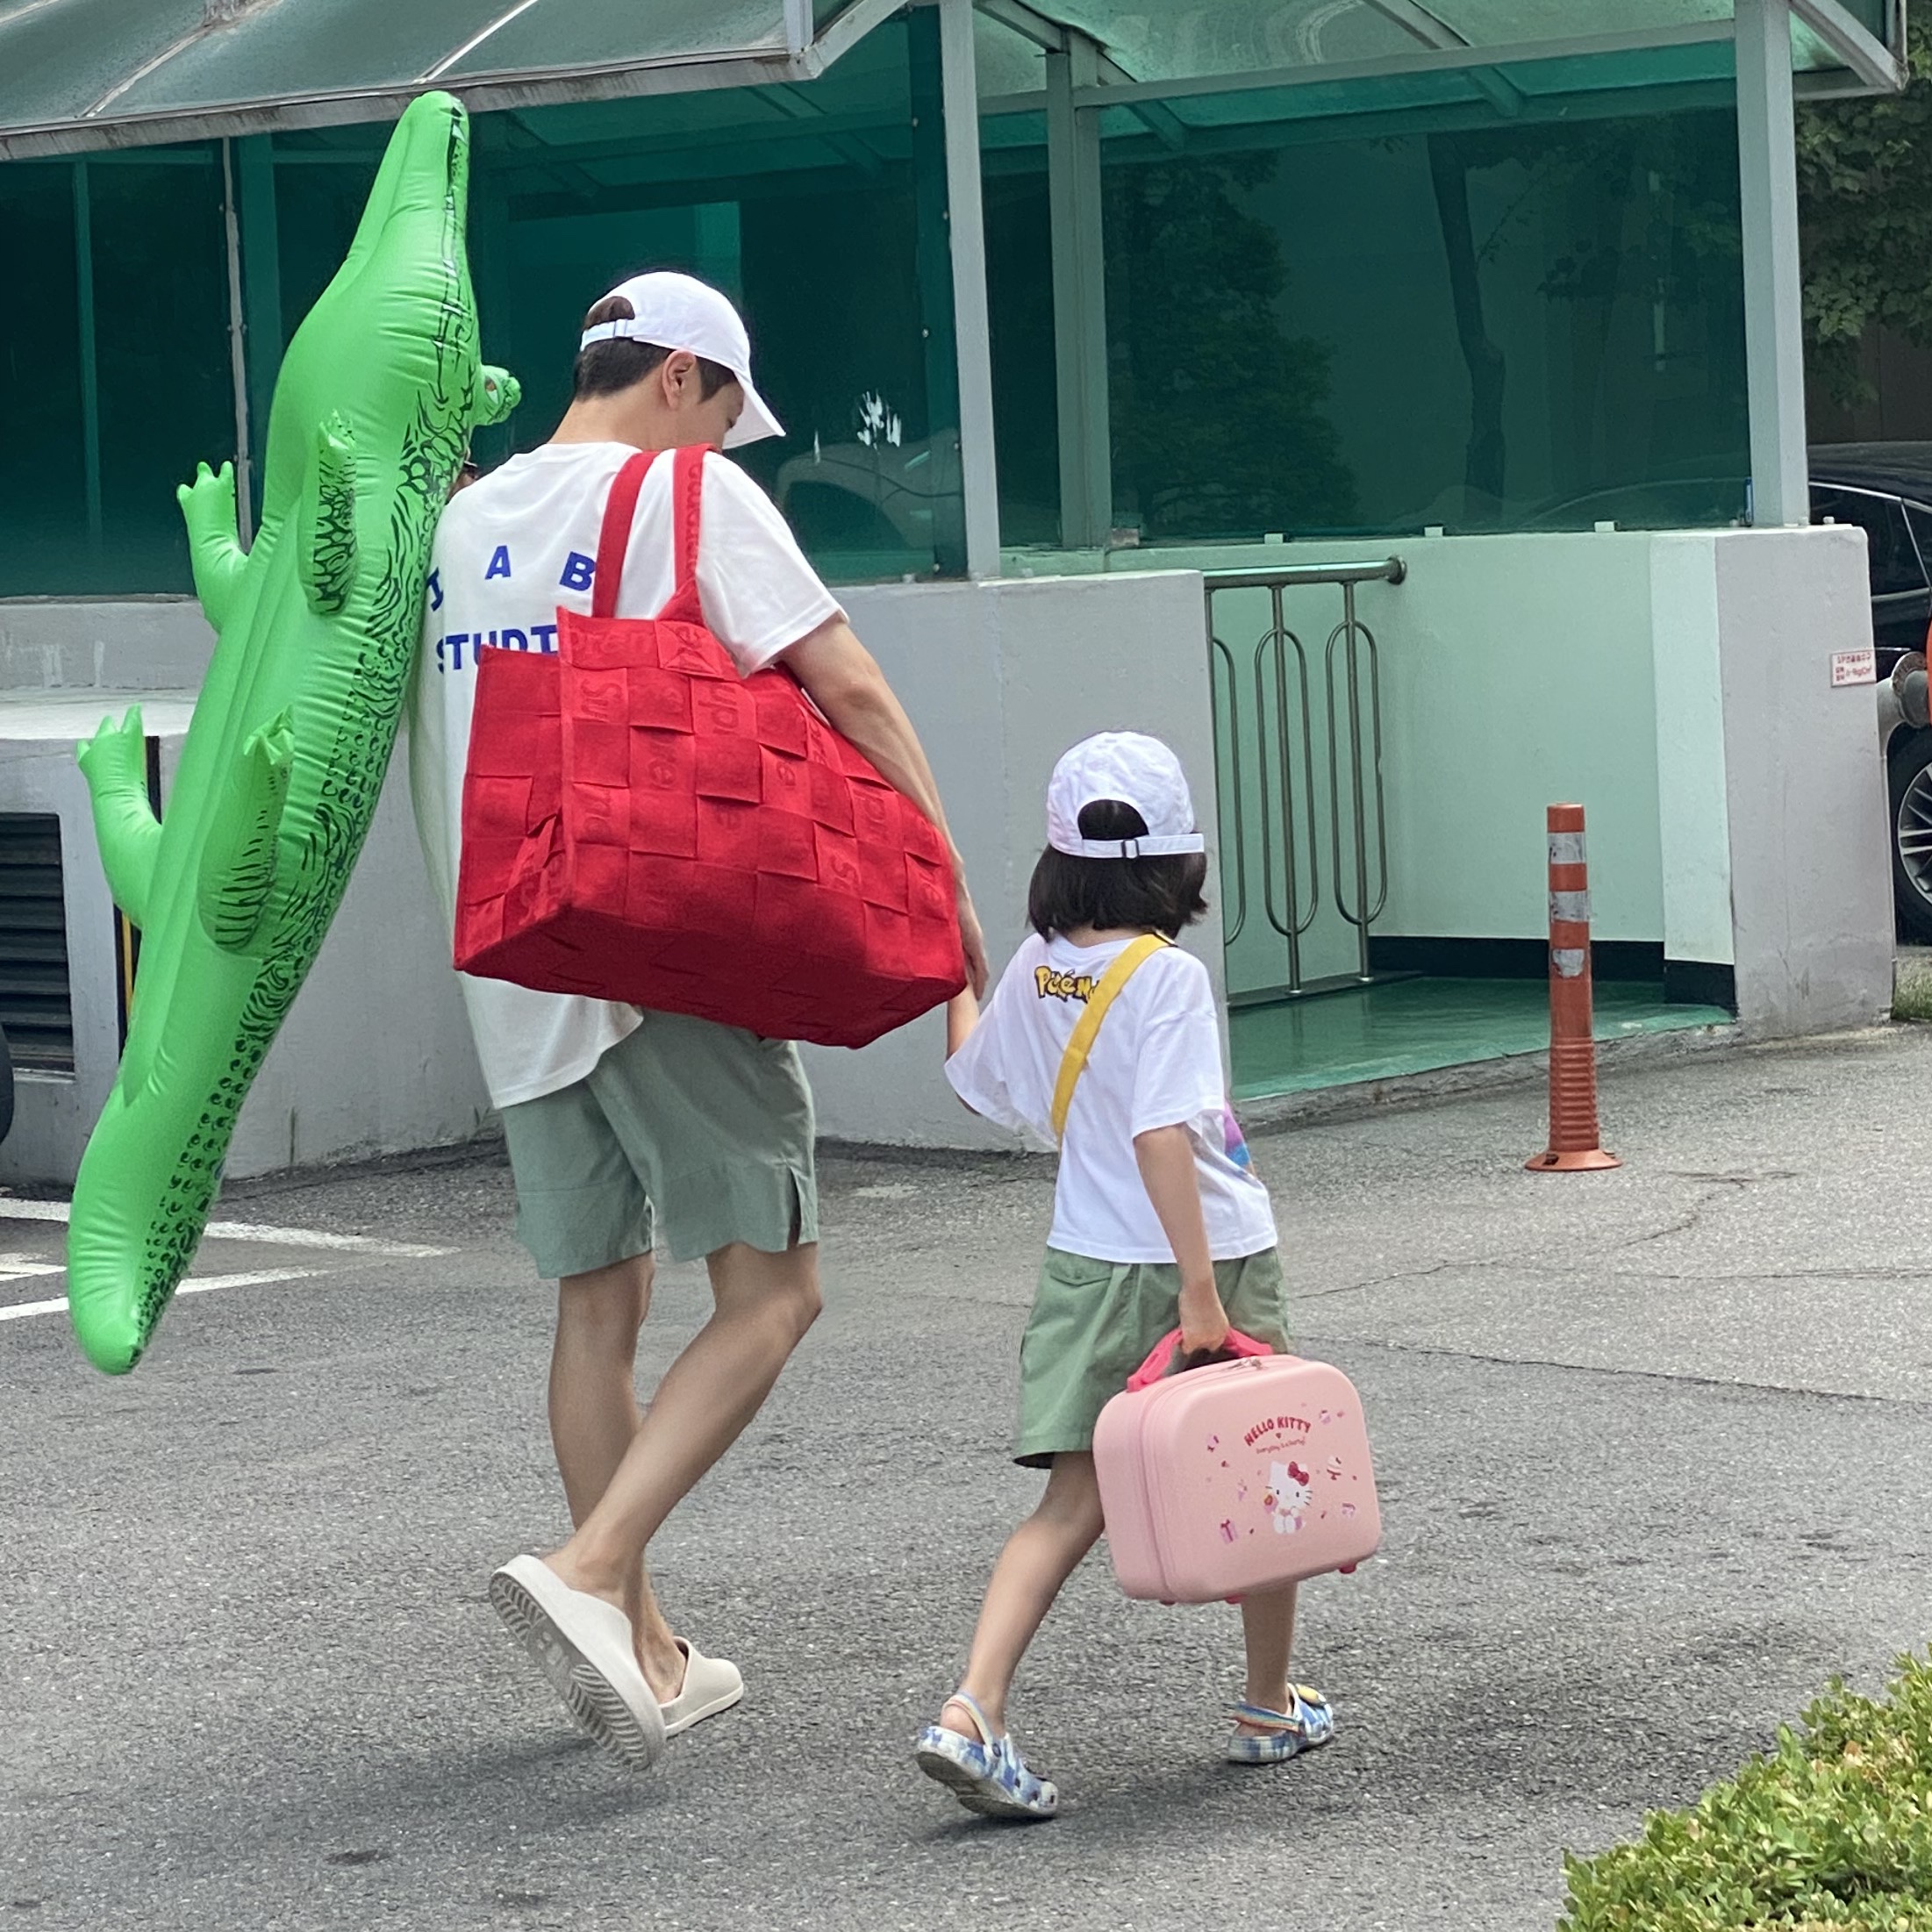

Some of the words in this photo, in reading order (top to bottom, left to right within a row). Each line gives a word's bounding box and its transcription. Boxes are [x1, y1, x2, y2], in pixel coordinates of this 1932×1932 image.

[484, 545, 512, 580] A
[559, 551, 597, 591] B
[1244, 1418, 1275, 1446] HELLO
[1277, 1416, 1312, 1433] KITTY
